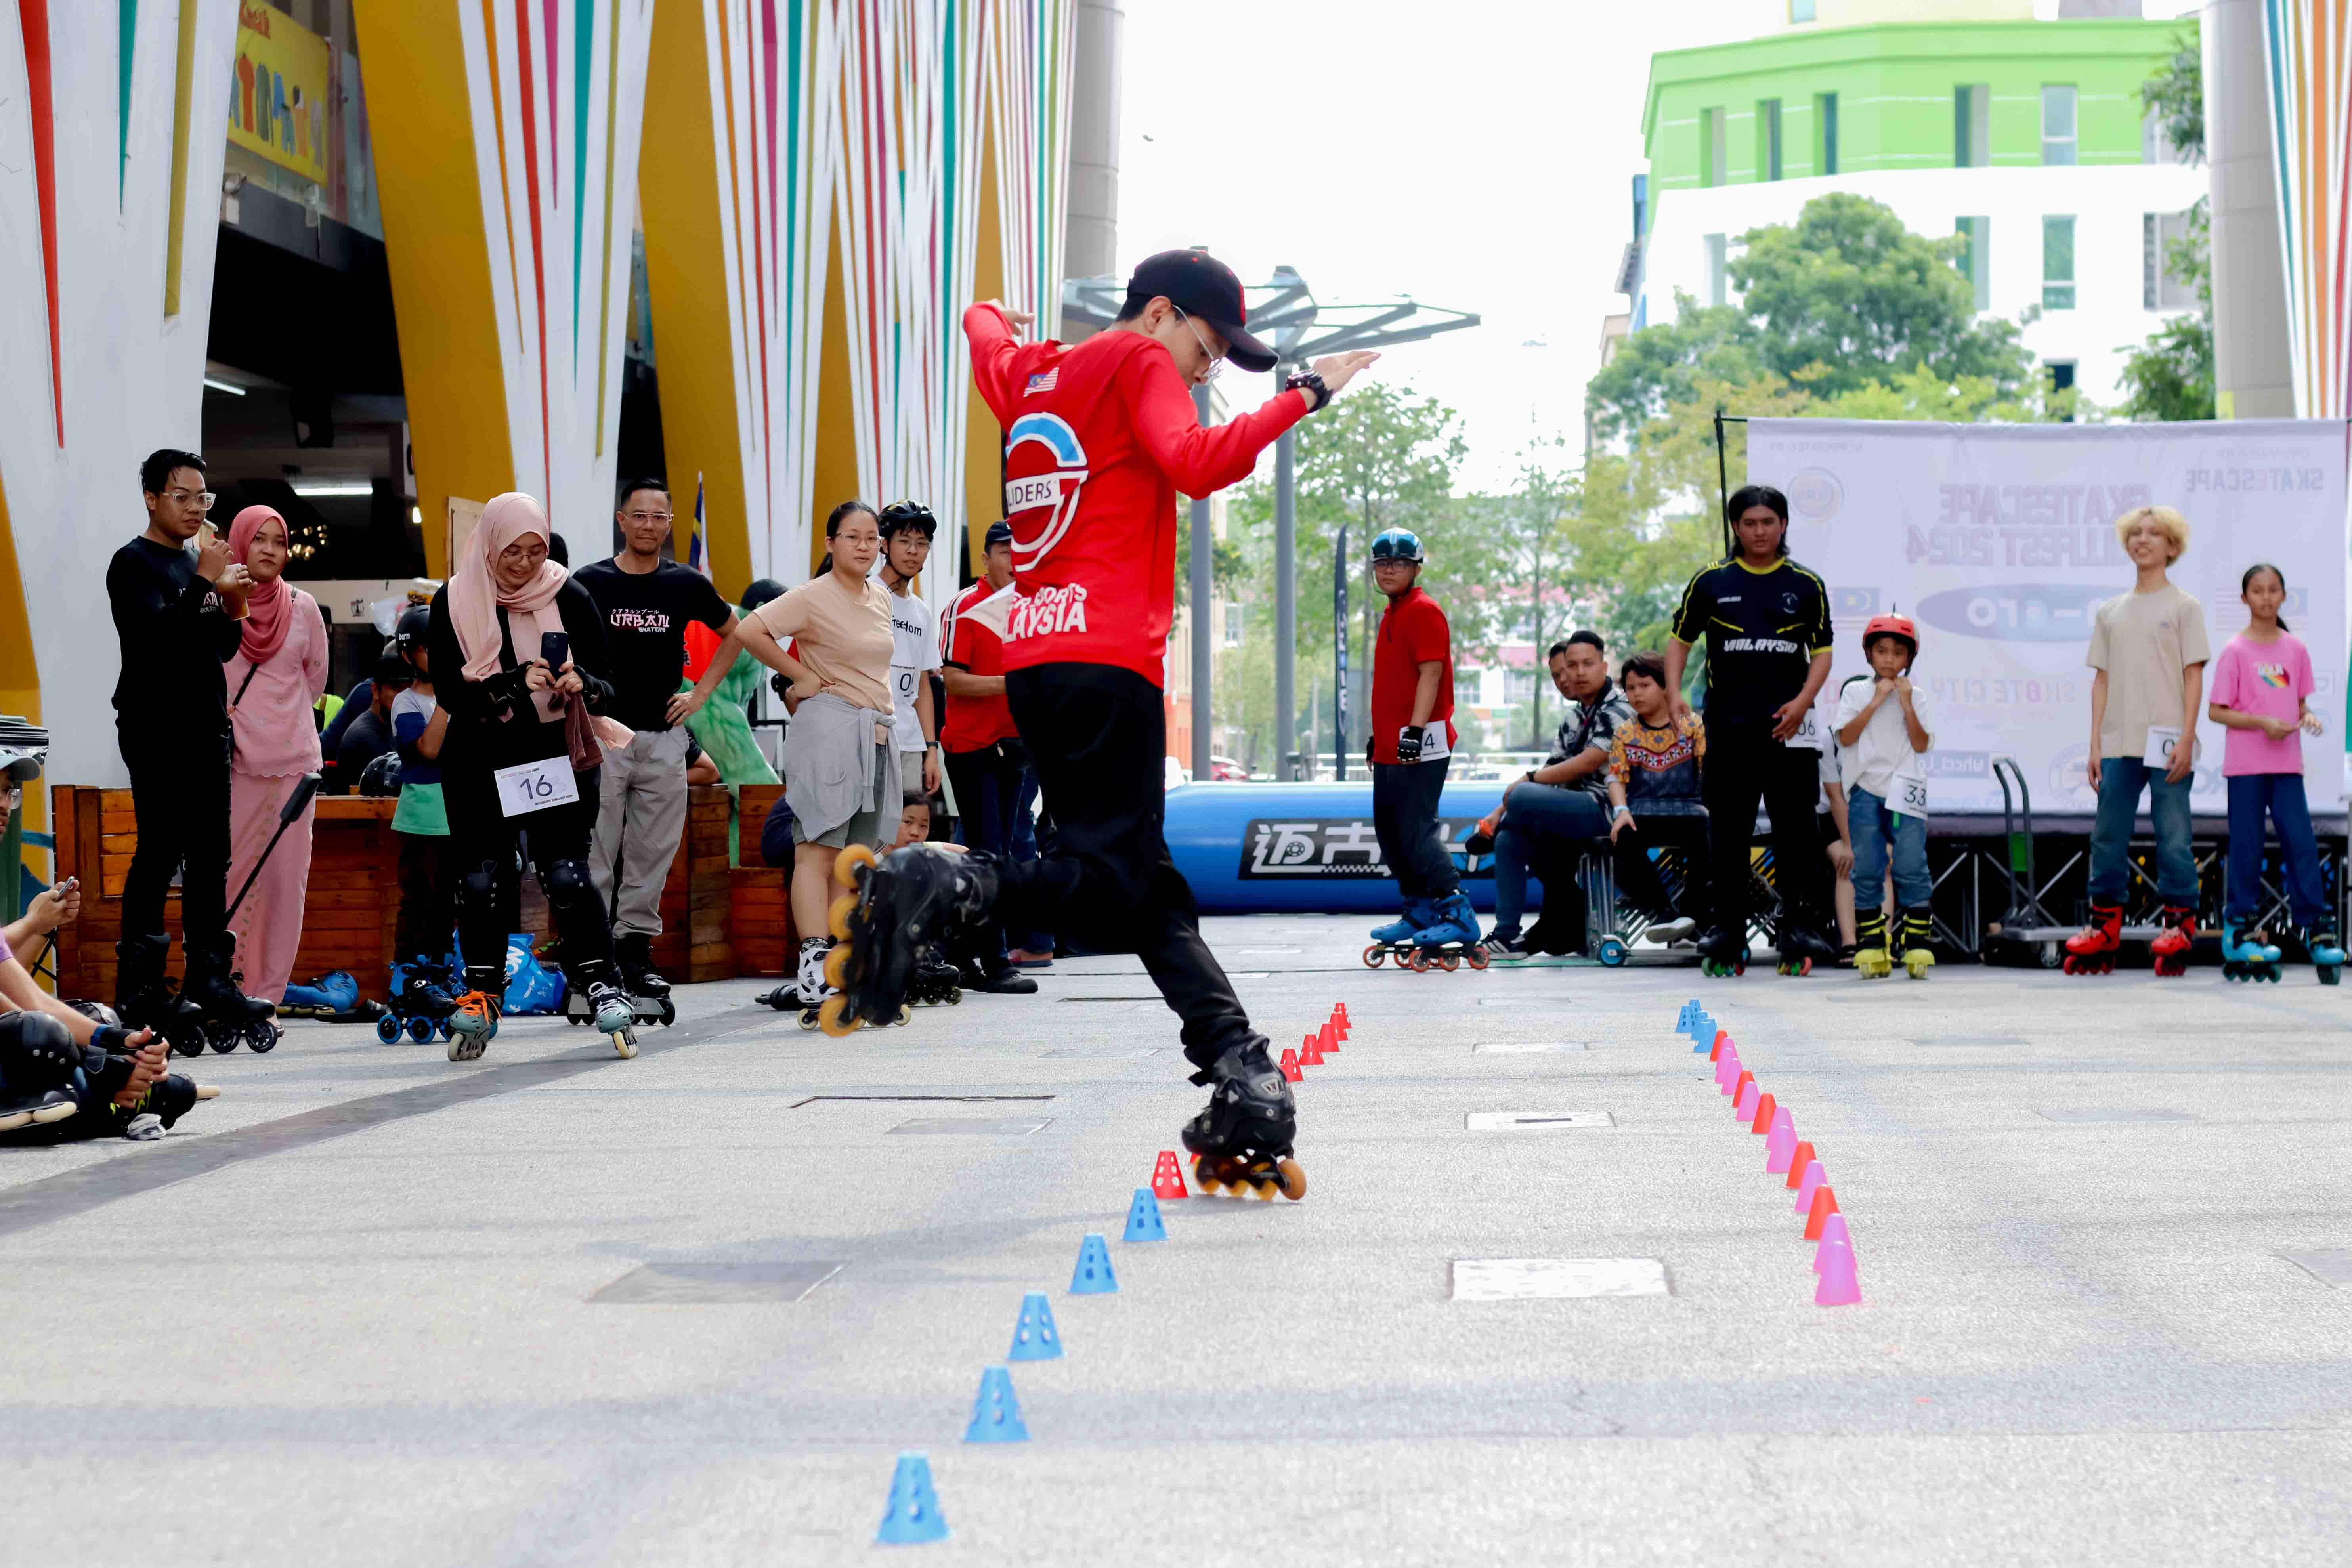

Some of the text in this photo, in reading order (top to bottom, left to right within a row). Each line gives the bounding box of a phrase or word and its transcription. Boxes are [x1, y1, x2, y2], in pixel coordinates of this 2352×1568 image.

[1007, 481, 1051, 506] LIDERS
[611, 614, 669, 627] URBAN
[1003, 602, 1087, 644] LAYSIA
[1424, 733, 1435, 749] 4
[520, 775, 552, 799] 16
[1904, 785, 1926, 806] 33
